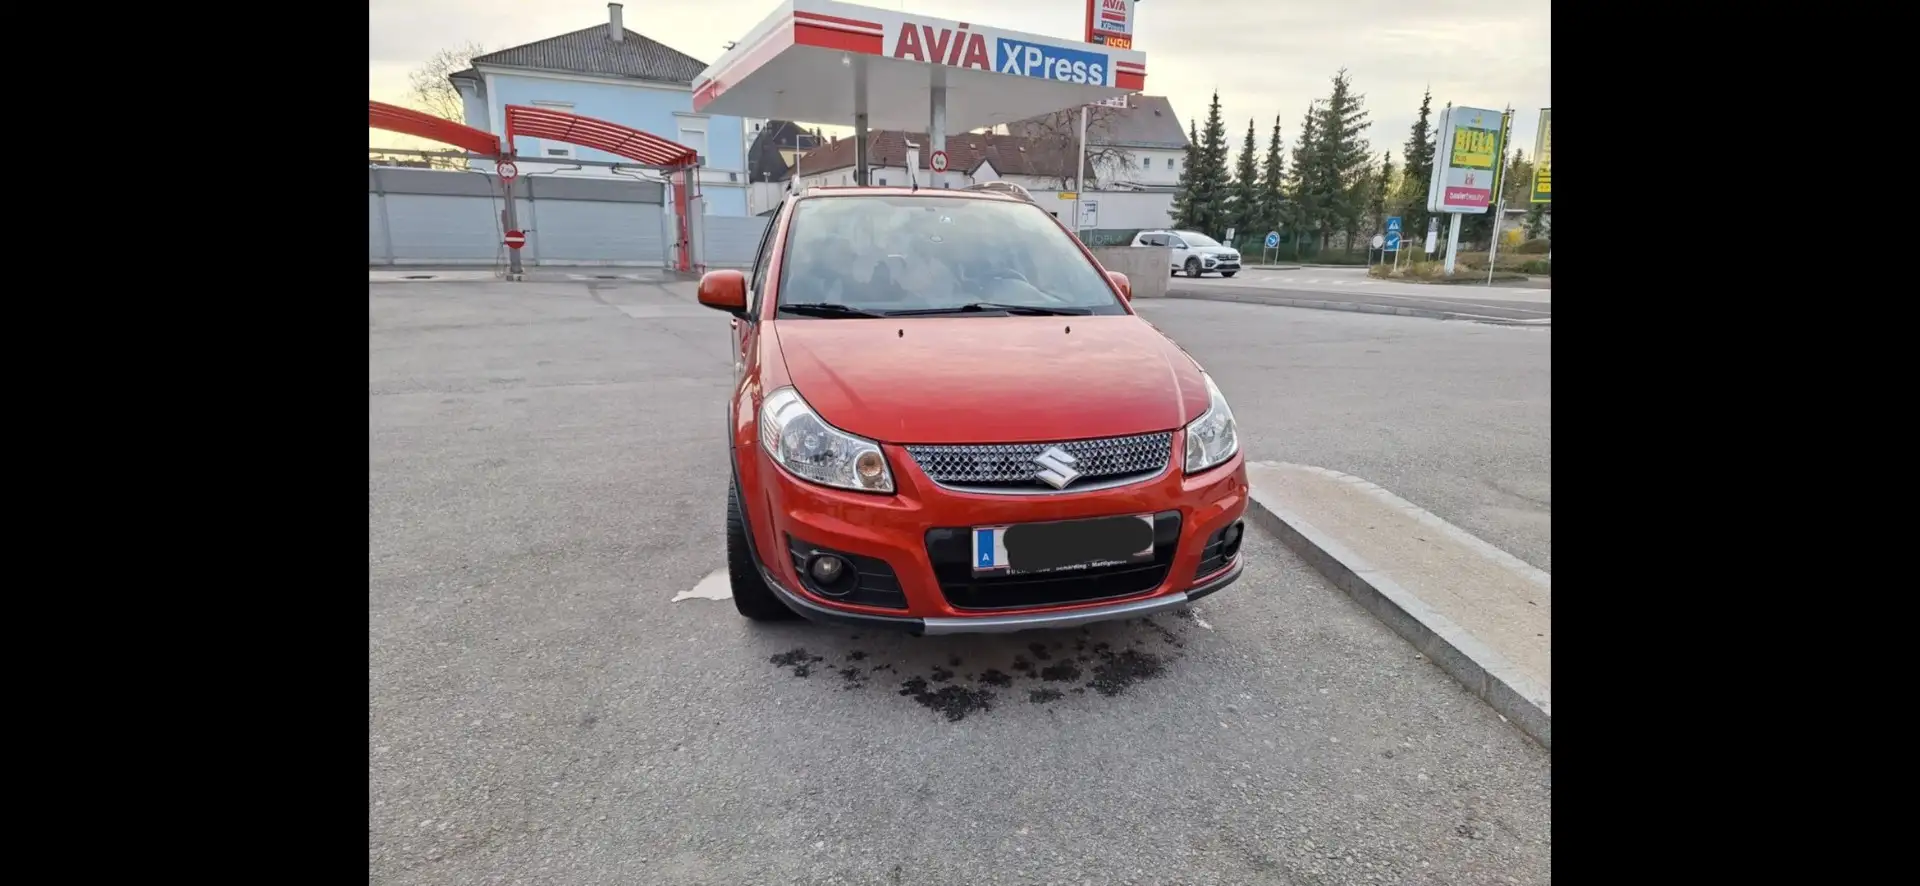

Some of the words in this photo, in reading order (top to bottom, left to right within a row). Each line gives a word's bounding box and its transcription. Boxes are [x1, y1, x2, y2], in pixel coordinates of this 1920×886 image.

[894, 22, 990, 71] AVIA
[1002, 42, 1103, 85] XPress
[982, 552, 990, 561] A
